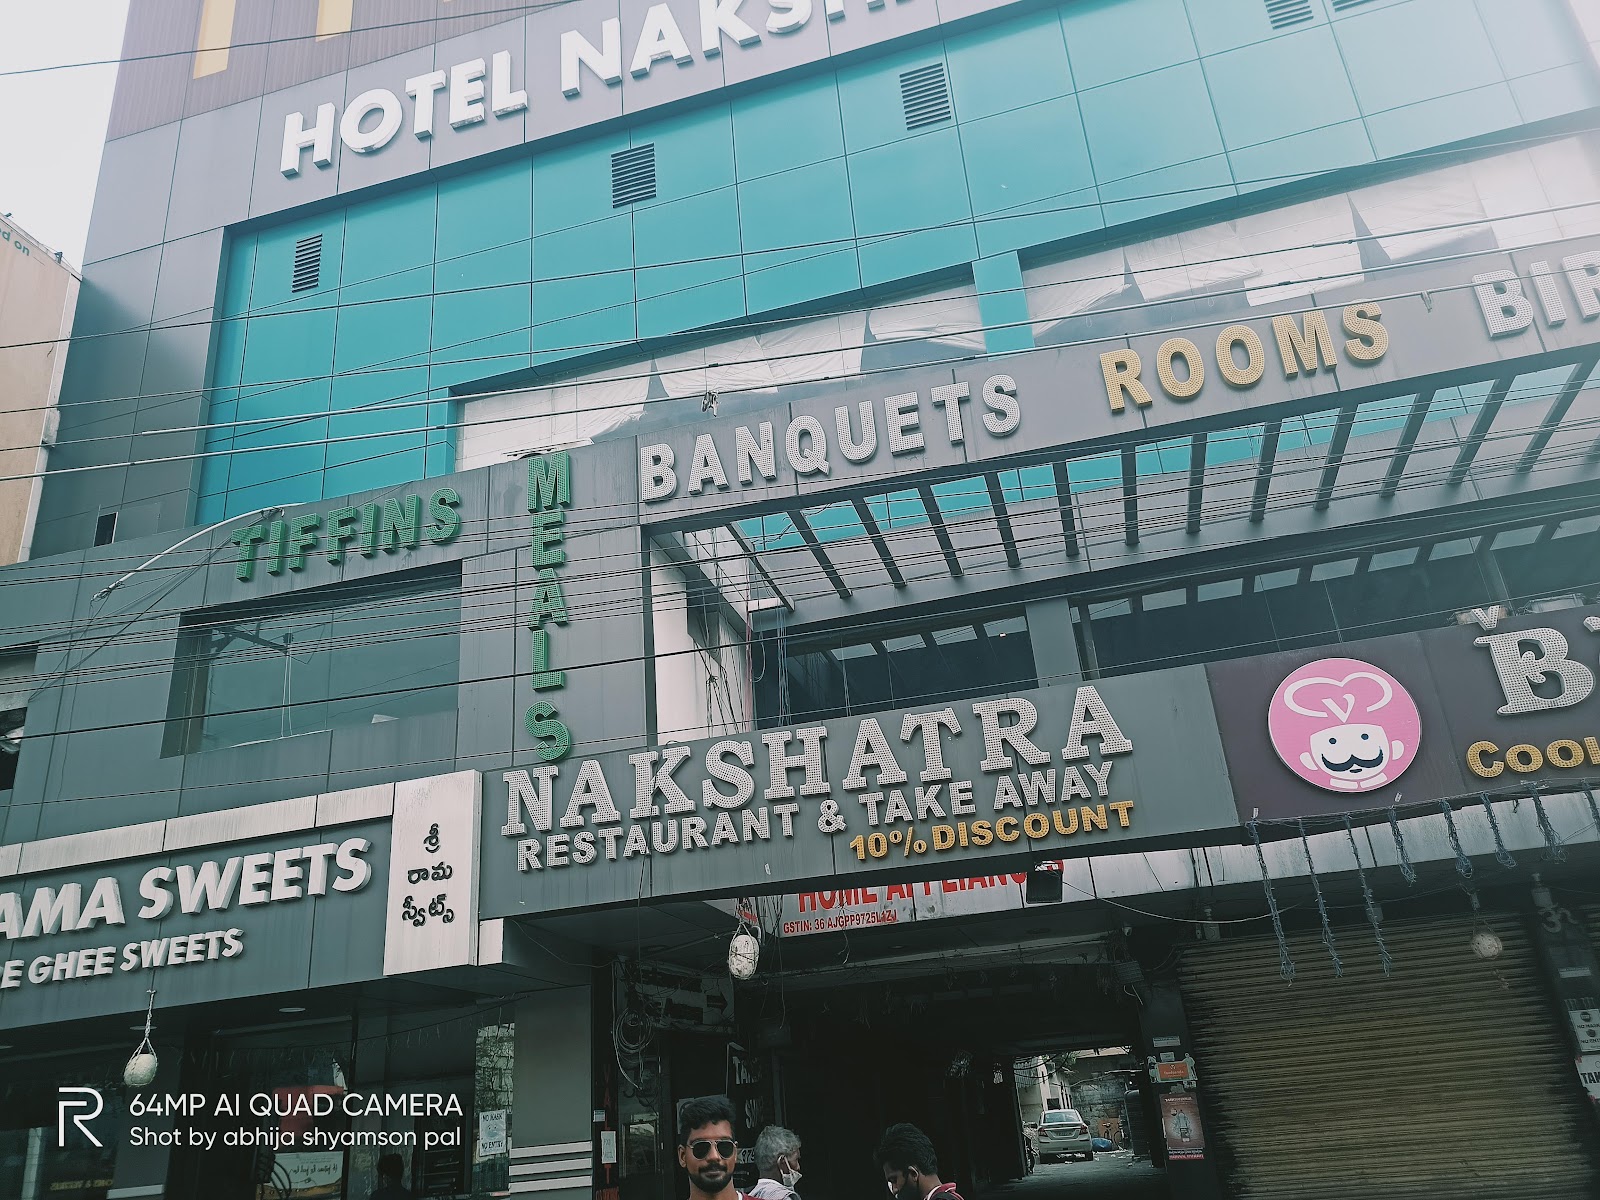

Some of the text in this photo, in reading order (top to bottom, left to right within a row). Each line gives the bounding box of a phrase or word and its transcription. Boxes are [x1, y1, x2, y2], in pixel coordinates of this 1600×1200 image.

[280, 50, 527, 178] HOTEL
[14, 240, 30, 257] on
[639, 300, 1389, 503] BANQUETS ROOMS
[231, 487, 461, 582] TIFFINS
[524, 451, 571, 761] MEALS
[501, 685, 1133, 837] NAKSHATRA
[423, 823, 441, 853] శ్రీ
[517, 761, 1113, 873] RESTAURANT & TAKE AWAY
[932, 800, 1134, 851] DISCOUNT
[138, 838, 372, 920] SWEETS
[407, 861, 453, 884] రామ
[28, 946, 117, 984] GHEE
[119, 928, 244, 972] SWEETS
[783, 920, 812, 934] GSTIN:
[814, 917, 825, 930] 36
